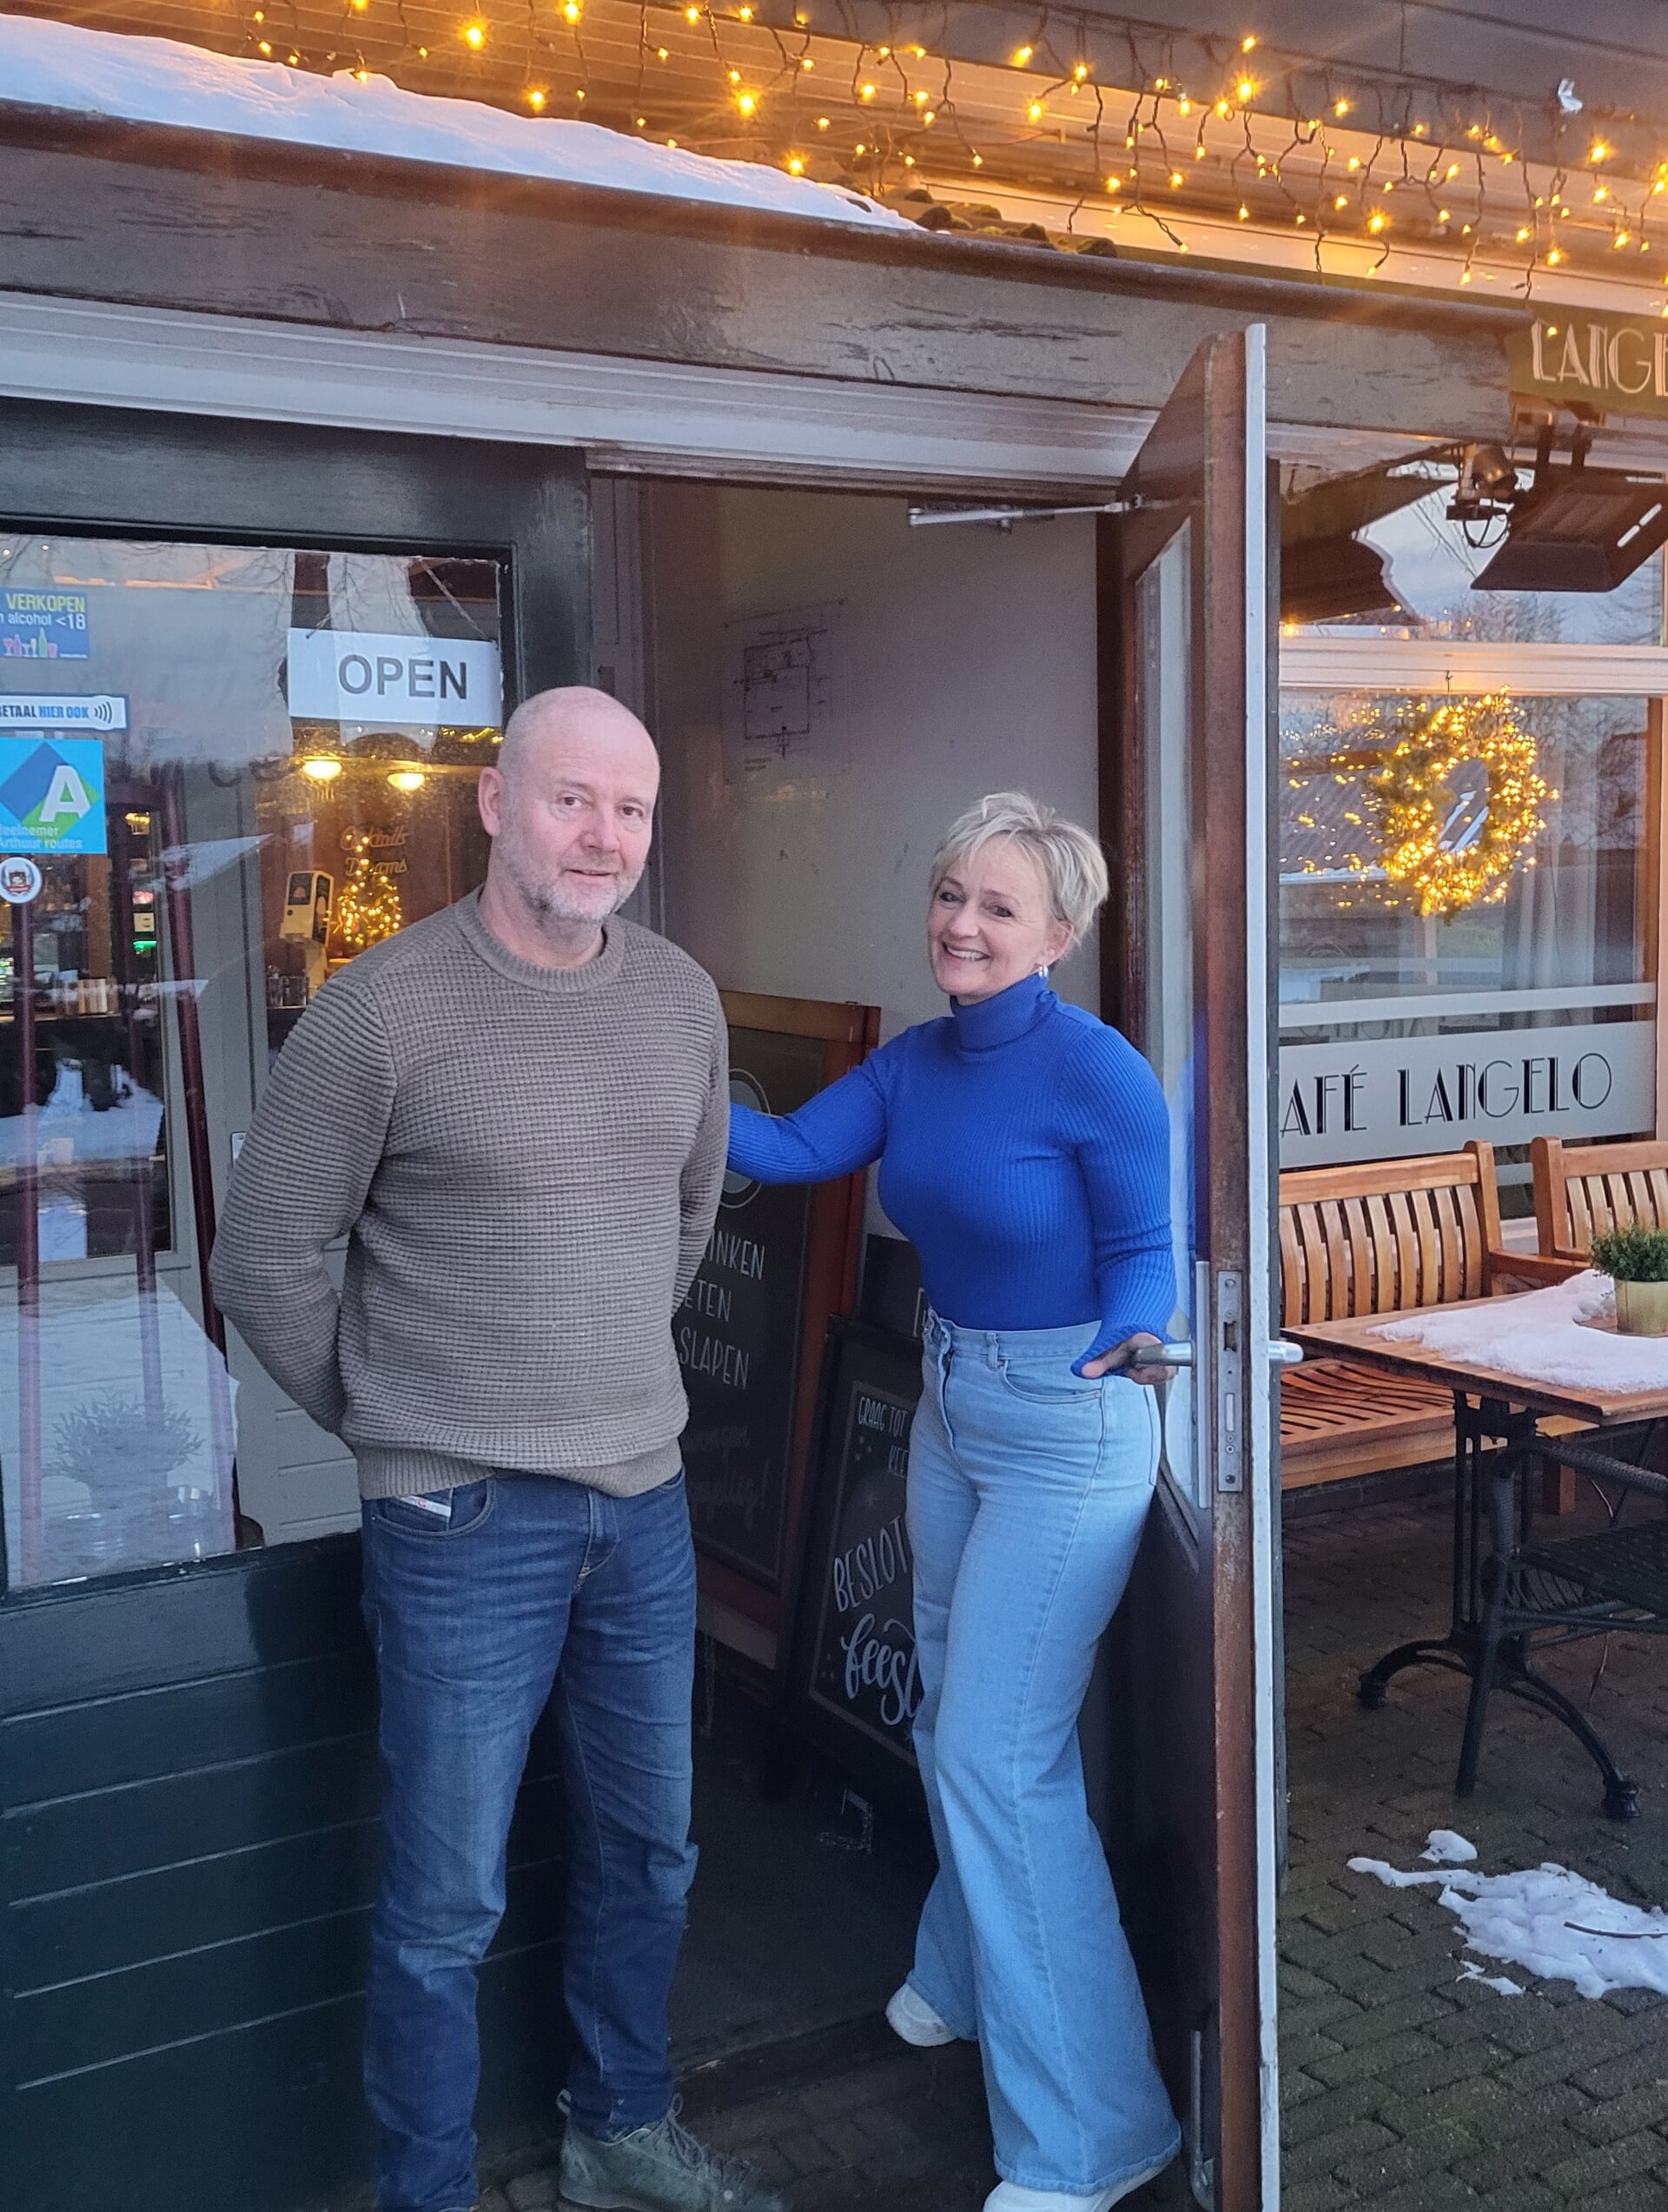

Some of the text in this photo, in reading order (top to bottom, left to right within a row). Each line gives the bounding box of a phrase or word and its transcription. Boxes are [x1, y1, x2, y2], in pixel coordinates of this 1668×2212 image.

[5, 593, 85, 613] VERKOPEN
[8, 612, 52, 626] alcohol
[55, 613, 86, 631] <18
[339, 653, 467, 700] OPEN
[0, 705, 89, 719] ETAAL HIER OOK
[39, 765, 91, 823] A
[0, 824, 59, 837] eelnemer
[1280, 1052, 1612, 1138] AFÉ LANGELO
[705, 1229, 765, 1281] INKEN
[679, 1326, 750, 1389] SLAPEN
[858, 1396, 909, 1438] GRAAG TOT
